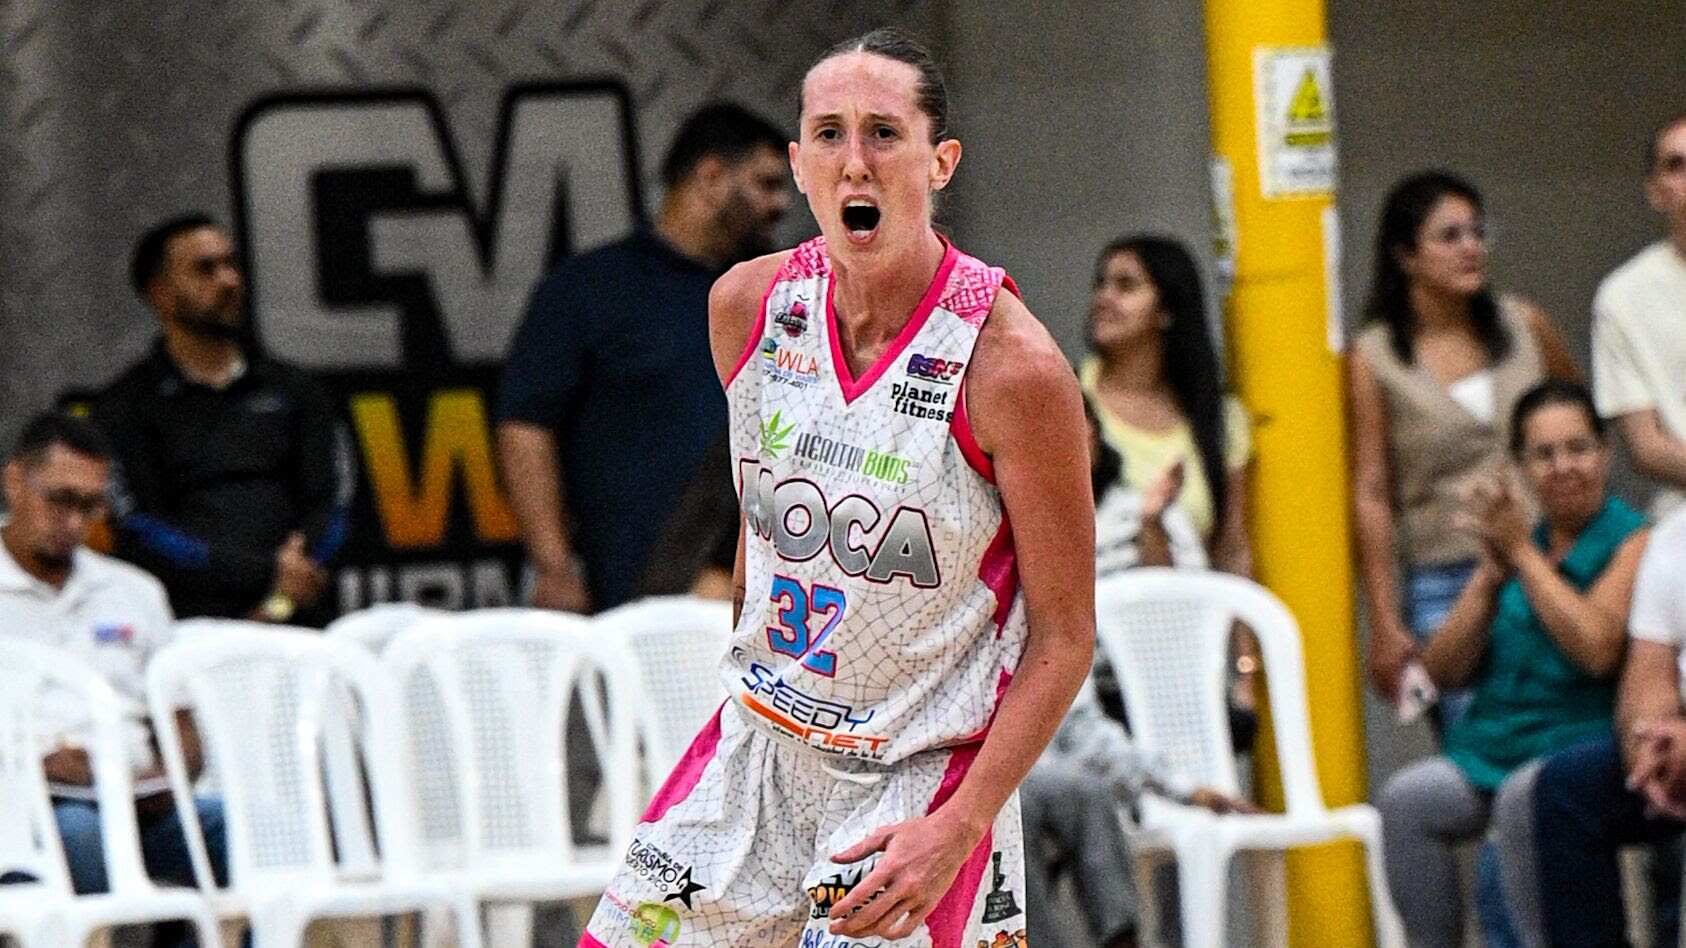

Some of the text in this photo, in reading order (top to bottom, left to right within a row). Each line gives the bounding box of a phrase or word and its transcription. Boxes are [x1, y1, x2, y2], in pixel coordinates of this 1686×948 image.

[775, 347, 819, 377] WLA
[891, 381, 948, 405] planet
[894, 396, 954, 423] fitness
[863, 448, 911, 484] BUDS
[767, 574, 846, 678] 32
[741, 662, 876, 733] SPEEDY
